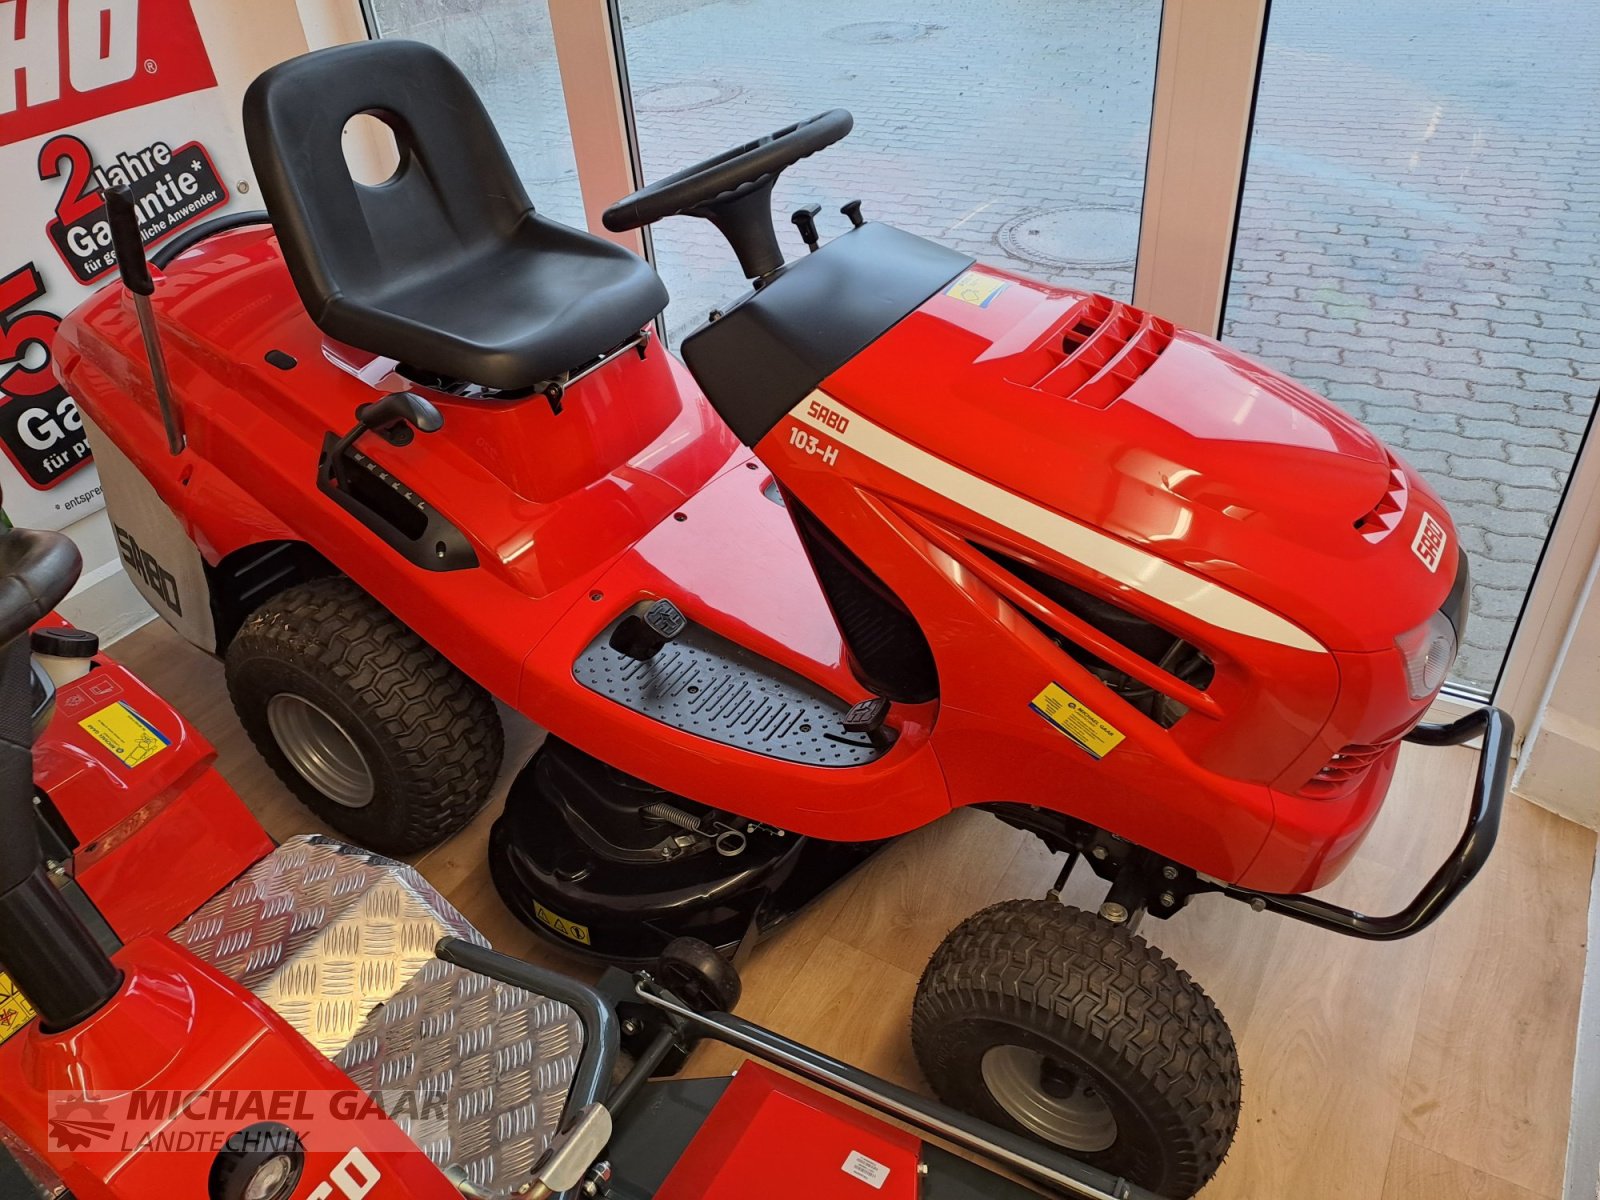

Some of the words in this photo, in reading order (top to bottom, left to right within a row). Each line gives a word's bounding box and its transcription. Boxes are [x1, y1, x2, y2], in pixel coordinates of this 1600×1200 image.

[39, 134, 107, 227] 2
[93, 141, 172, 198] Jahre
[66, 160, 202, 258] Gantie
[84, 257, 102, 274] für
[167, 190, 218, 226] Anwender
[806, 400, 850, 435] SABO
[42, 453, 70, 473] für
[789, 426, 840, 467] 103-H
[114, 521, 182, 617] SABO
[1416, 517, 1444, 568] SABO
